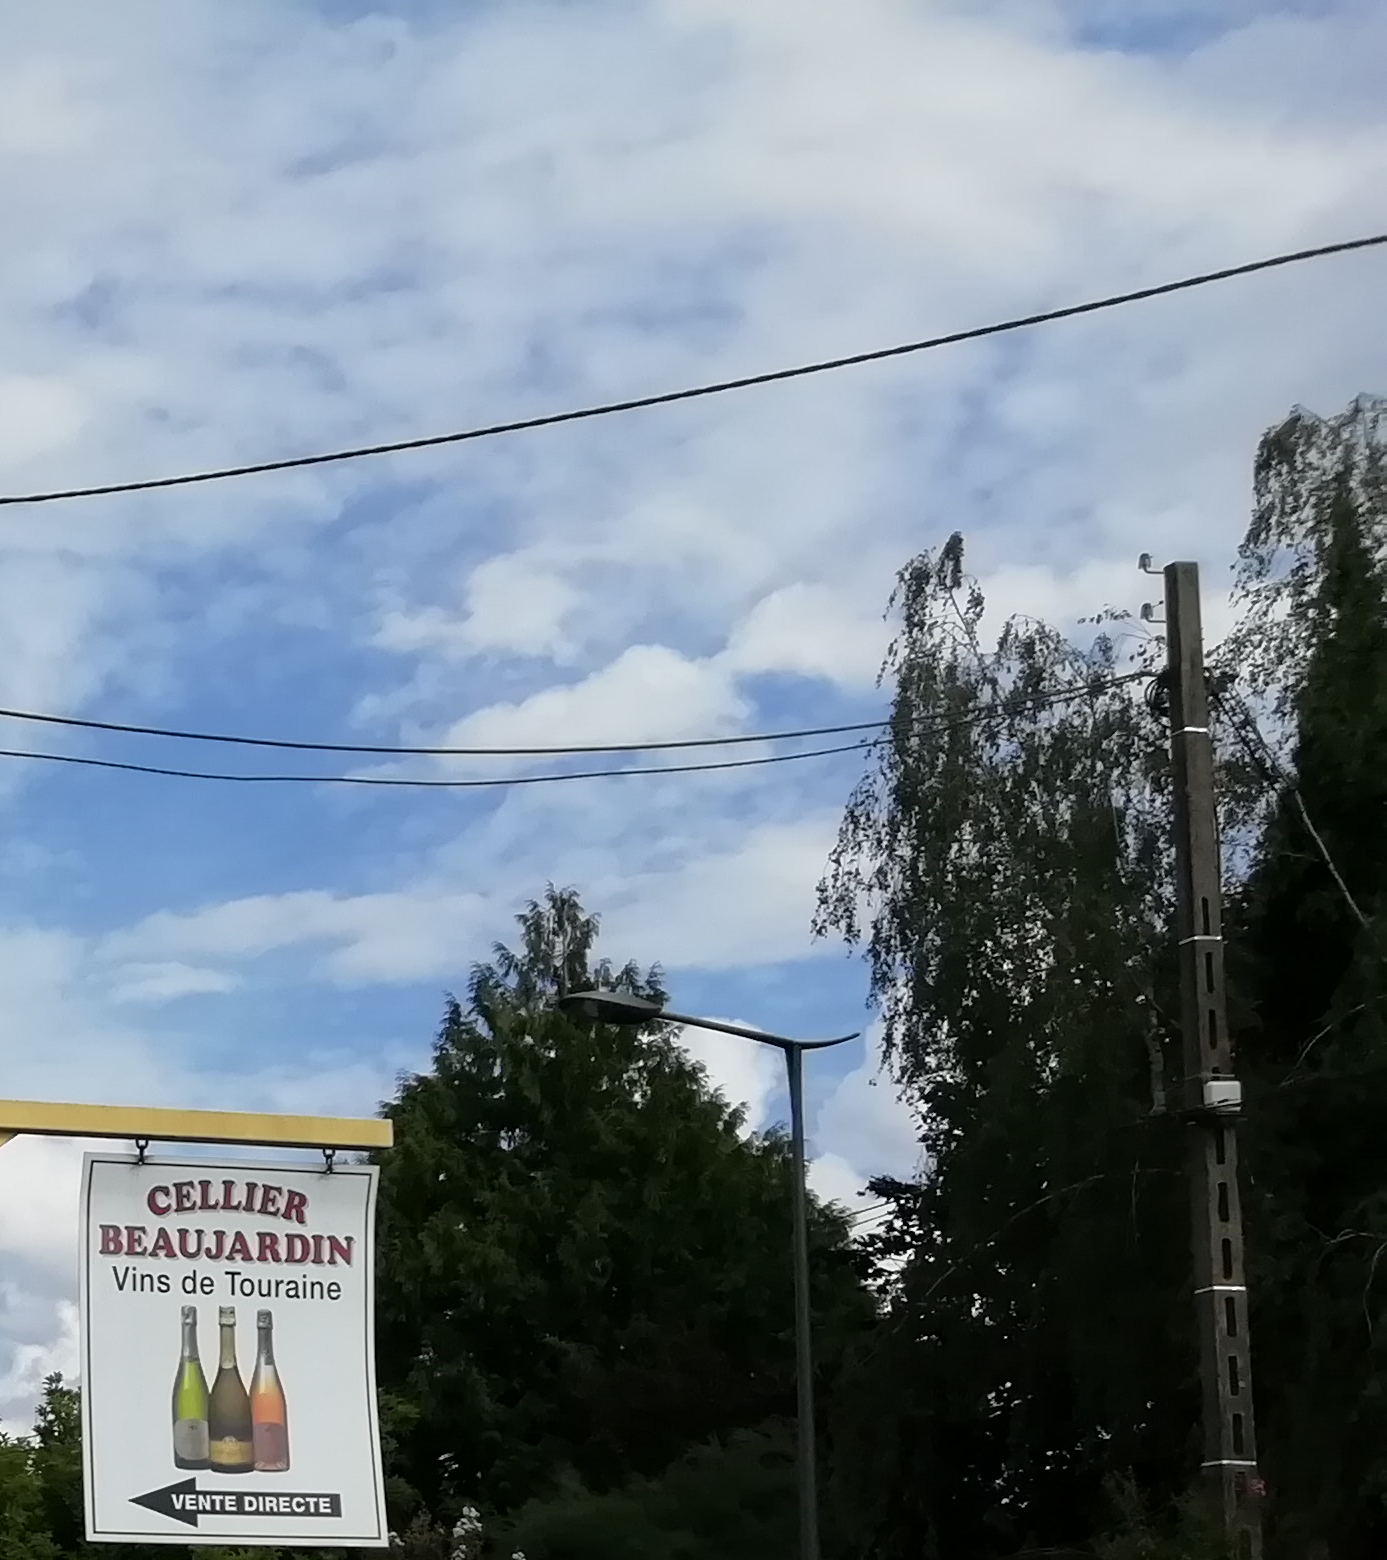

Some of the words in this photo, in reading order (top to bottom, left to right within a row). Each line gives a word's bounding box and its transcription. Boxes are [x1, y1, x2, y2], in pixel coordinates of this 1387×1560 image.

[146, 1179, 310, 1225] CELLIER
[98, 1223, 355, 1267] BEAUJARDIN
[112, 1265, 171, 1293] Vins
[181, 1269, 215, 1296] de
[224, 1271, 342, 1301] Touraine
[170, 1493, 238, 1513] VENTE
[243, 1495, 333, 1514] DIRECTE
